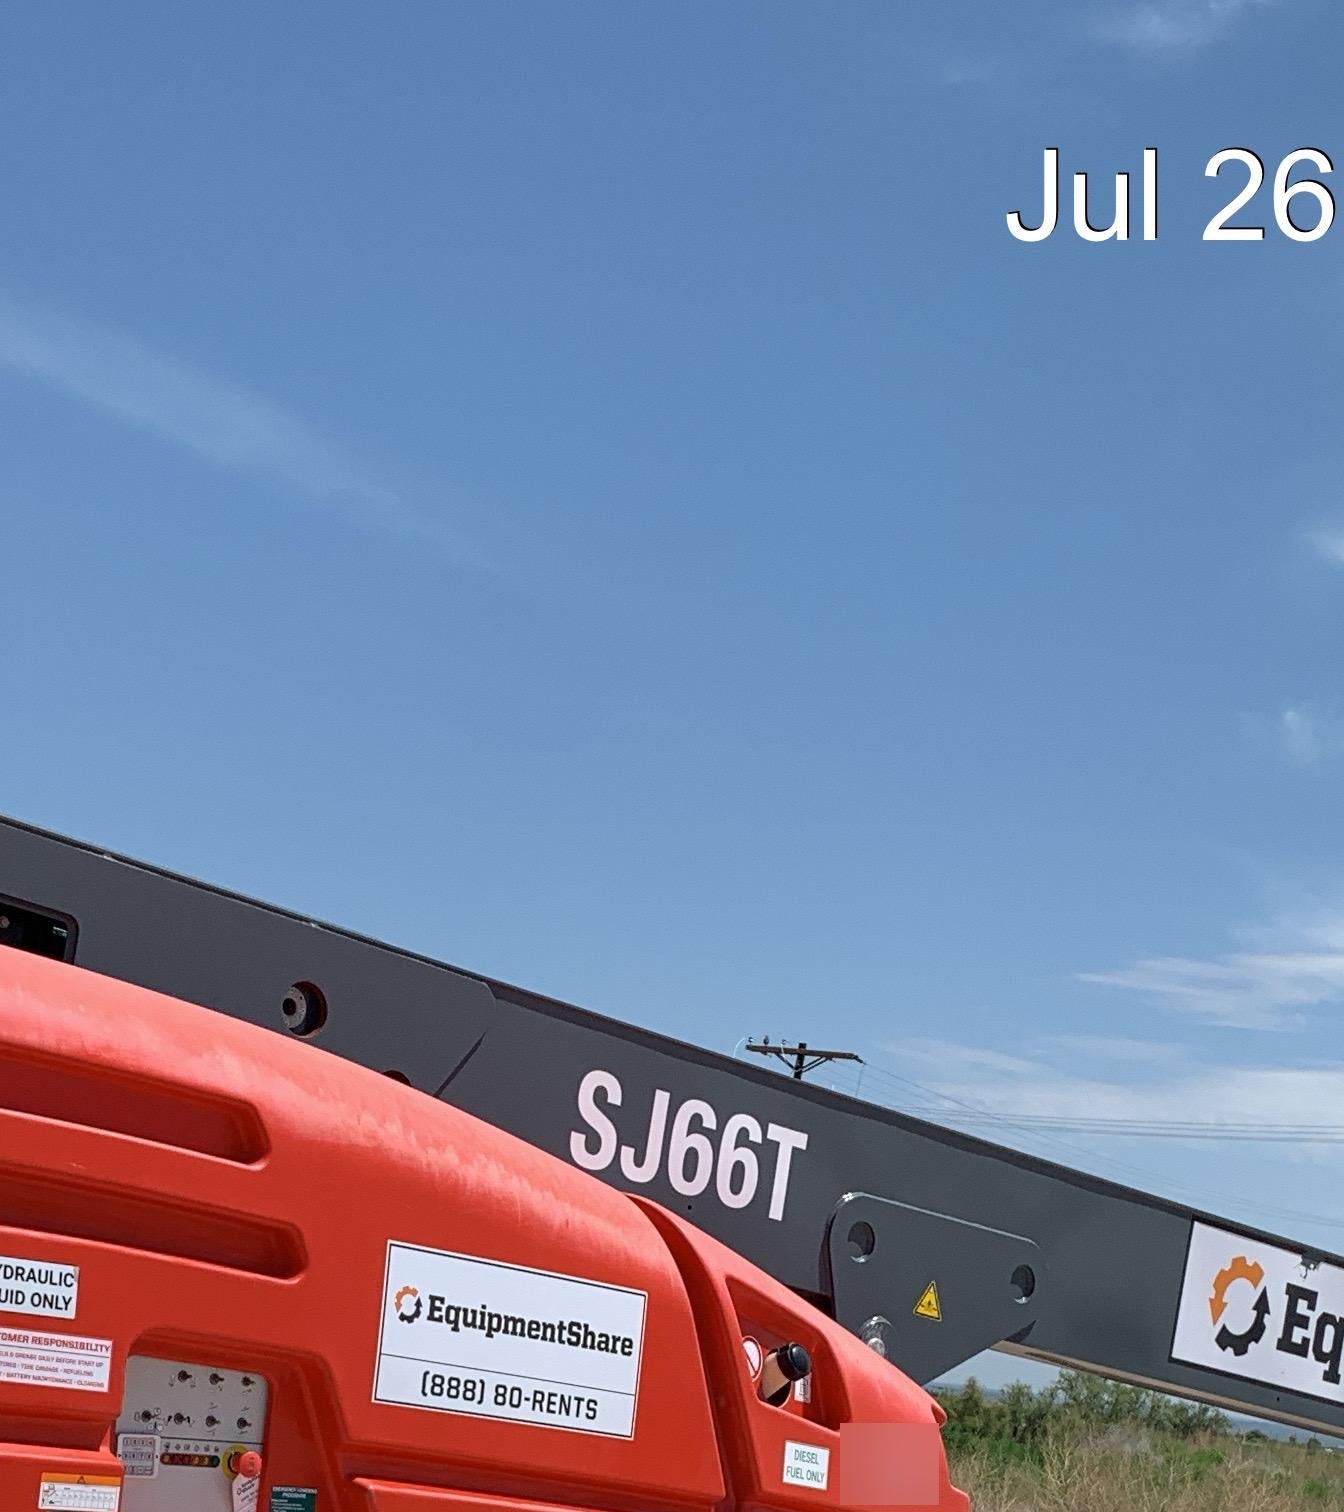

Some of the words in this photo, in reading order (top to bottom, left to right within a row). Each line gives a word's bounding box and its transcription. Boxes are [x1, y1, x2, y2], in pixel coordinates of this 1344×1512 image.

[570, 1069, 809, 1222] SJ66T
[30, 1291, 73, 1311] ONLY
[426, 1294, 634, 1357] EquipmentShare
[31, 1336, 111, 1353] RESPONSIBILITY
[420, 1370, 486, 1405] (888)
[493, 1383, 599, 1421] 80-RENTS
[793, 1449, 820, 1465] DIESEL
[785, 1465, 805, 1480] FUEL
[806, 1469, 825, 1483] ONLY
